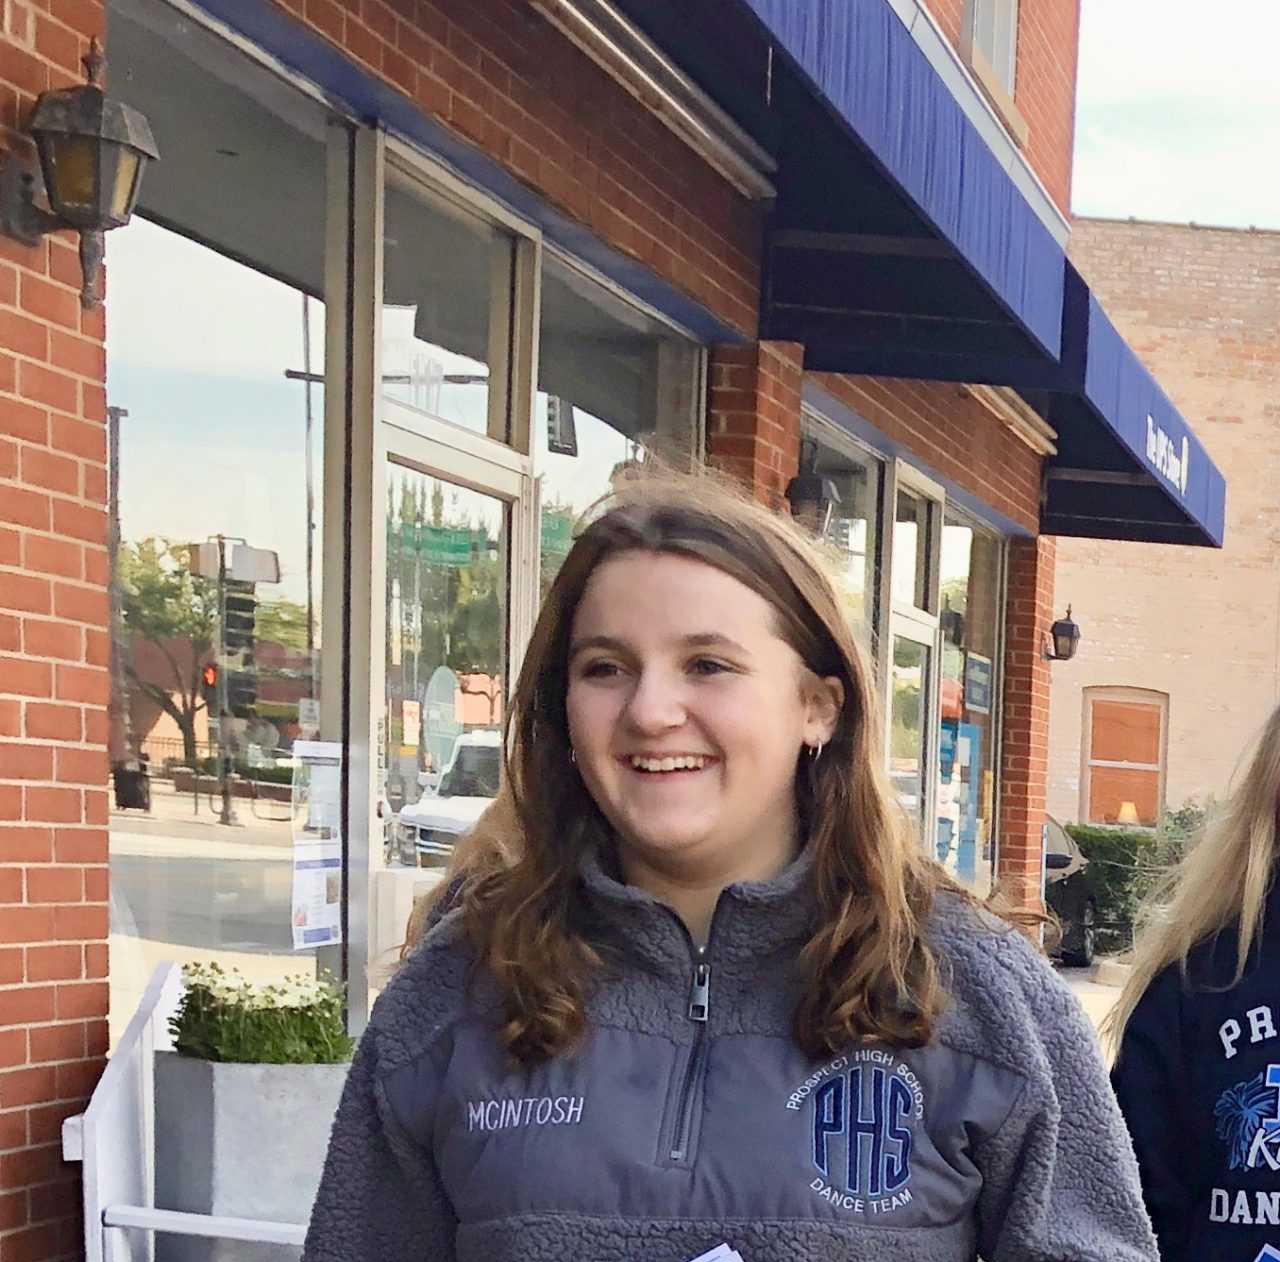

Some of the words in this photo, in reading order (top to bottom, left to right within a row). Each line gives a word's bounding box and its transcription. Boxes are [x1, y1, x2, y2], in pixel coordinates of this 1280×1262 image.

[855, 1049, 894, 1067] HIGH
[468, 1096, 584, 1132] MCINTOSH
[812, 1064, 914, 1197] PHS
[809, 1177, 865, 1213] DANCE
[871, 1188, 913, 1214] TEAM
